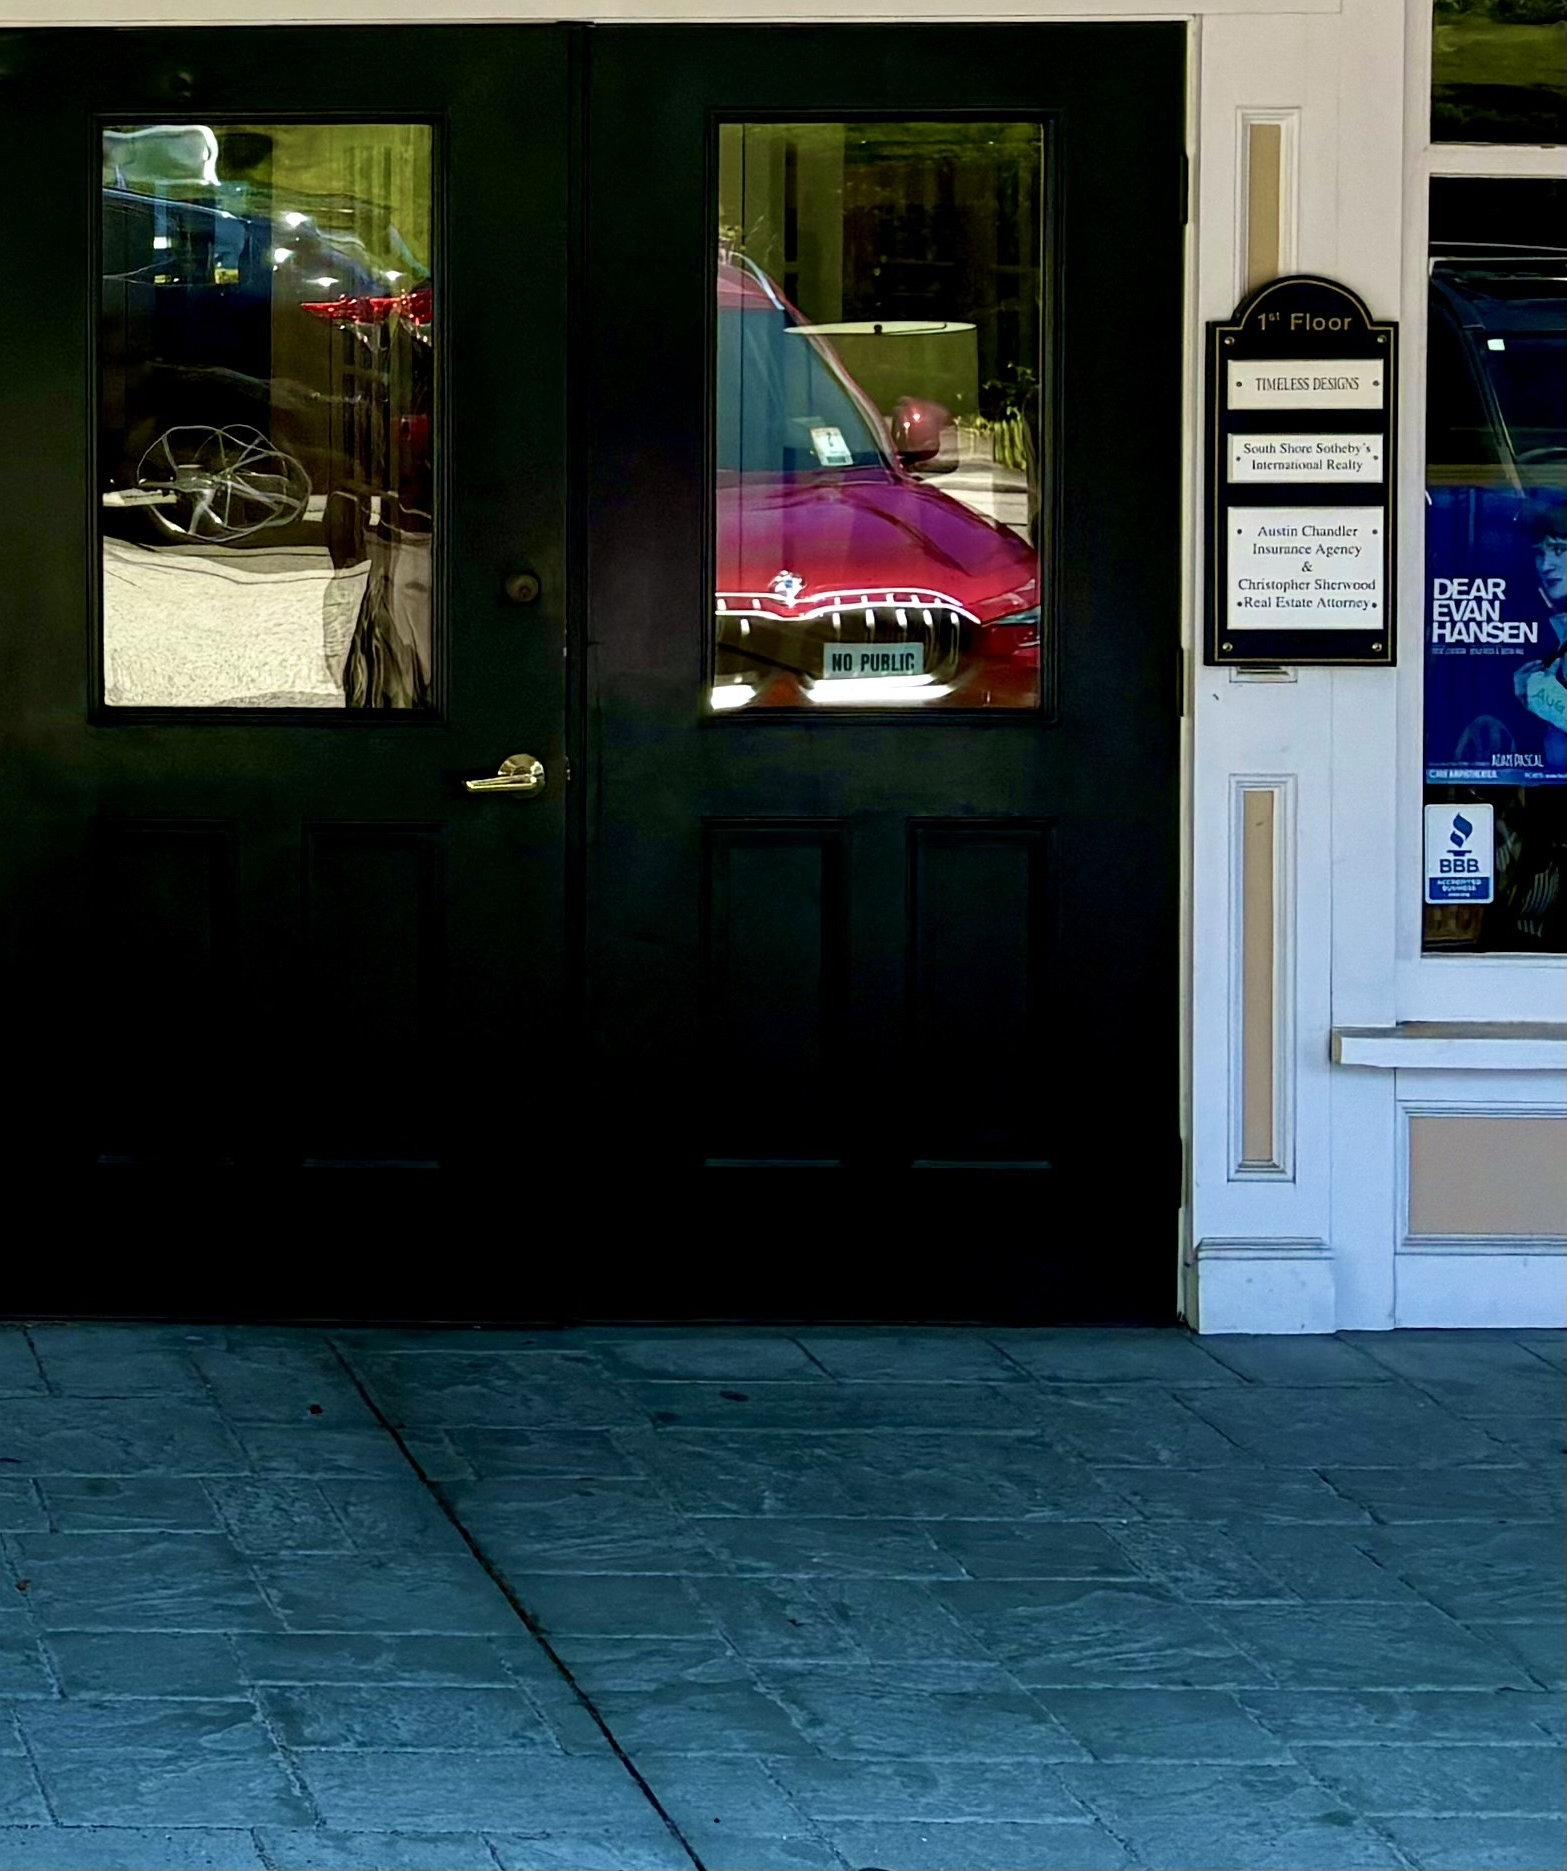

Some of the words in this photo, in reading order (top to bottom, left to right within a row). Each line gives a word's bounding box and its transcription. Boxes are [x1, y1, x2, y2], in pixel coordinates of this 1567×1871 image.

[1257, 312, 1281, 331] 1st
[1290, 312, 1353, 331] Floor
[1255, 377, 1310, 392] TIMELESS
[1312, 376, 1360, 391] DESIGNS
[1243, 442, 1276, 455] South
[1279, 442, 1313, 455] Shore
[1316, 441, 1372, 458] Sotheby's
[1252, 459, 1323, 471] International
[1326, 459, 1363, 473] Realty
[1257, 525, 1298, 537] Austin
[1301, 524, 1358, 537] Chandler
[1252, 543, 1312, 555] Insurance
[1315, 543, 1362, 558] Agency
[1301, 560, 1313, 573] &
[1238, 578, 1311, 593] Christopher
[1313, 579, 1376, 591] Sherwood
[1433, 578, 1507, 600] DEAR
[1244, 596, 1272, 608] Real
[1275, 596, 1313, 608] Estate
[1316, 596, 1370, 611] Attorney
[1432, 600, 1501, 621] EVAN
[1431, 621, 1538, 643] HANSEN
[832, 653, 853, 672] NO
[861, 653, 915, 672] PUBLIC
[1439, 858, 1479, 874] BBB
